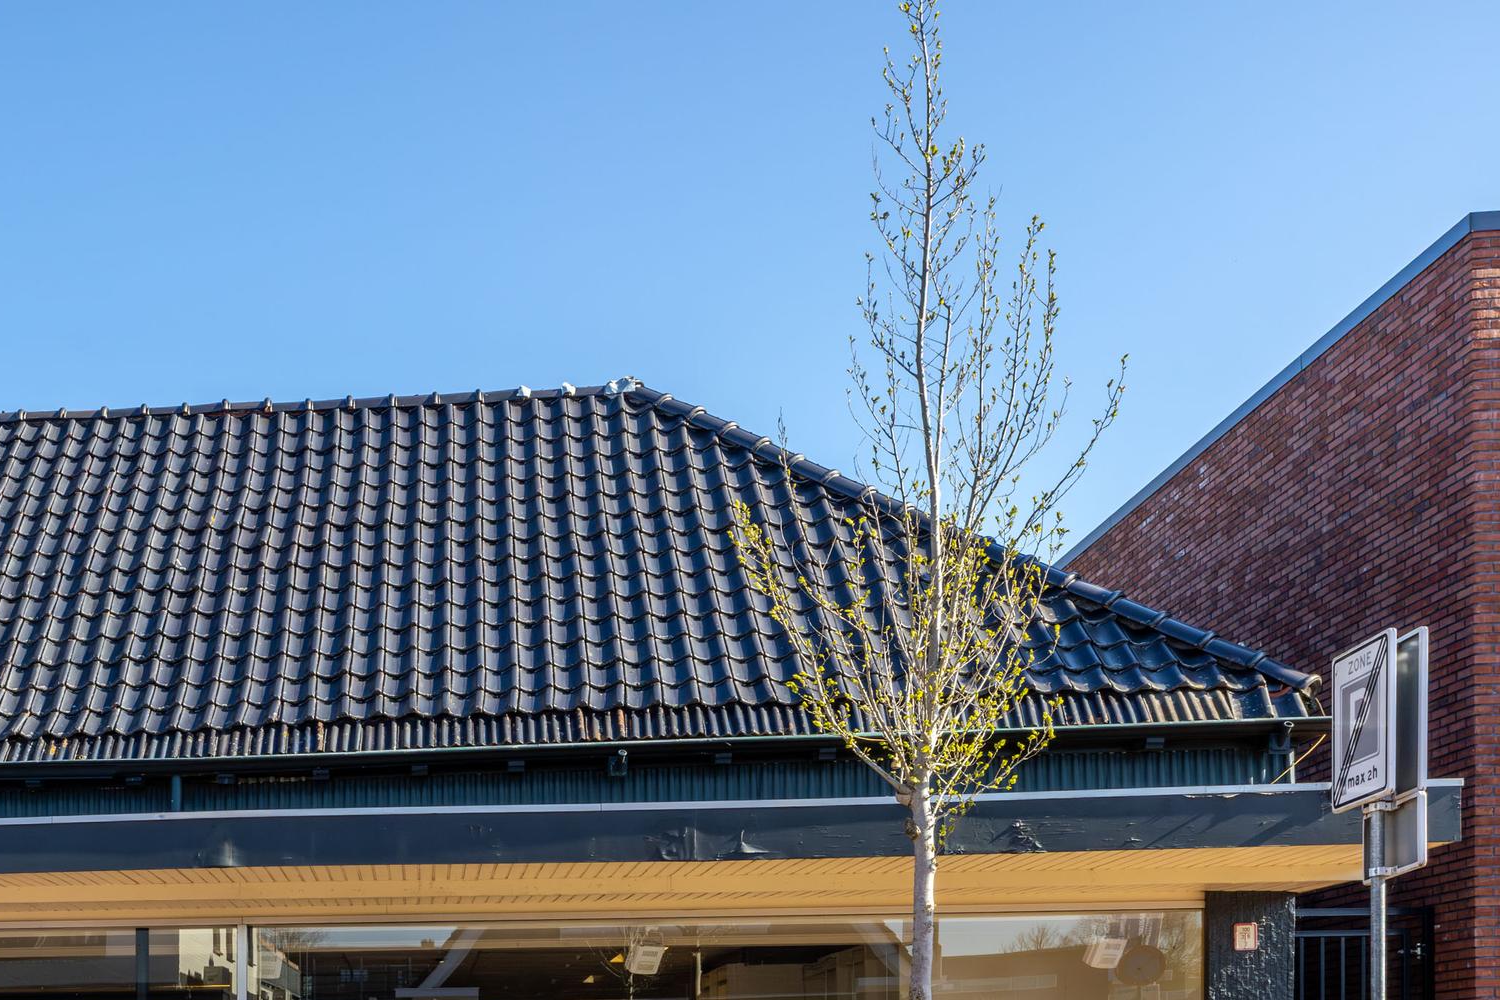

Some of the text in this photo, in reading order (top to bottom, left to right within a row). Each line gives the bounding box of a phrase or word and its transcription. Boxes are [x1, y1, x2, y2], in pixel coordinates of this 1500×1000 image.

[1348, 651, 1372, 675] ZONE
[1350, 687, 1371, 738] P
[1347, 765, 1378, 789] max 2h
